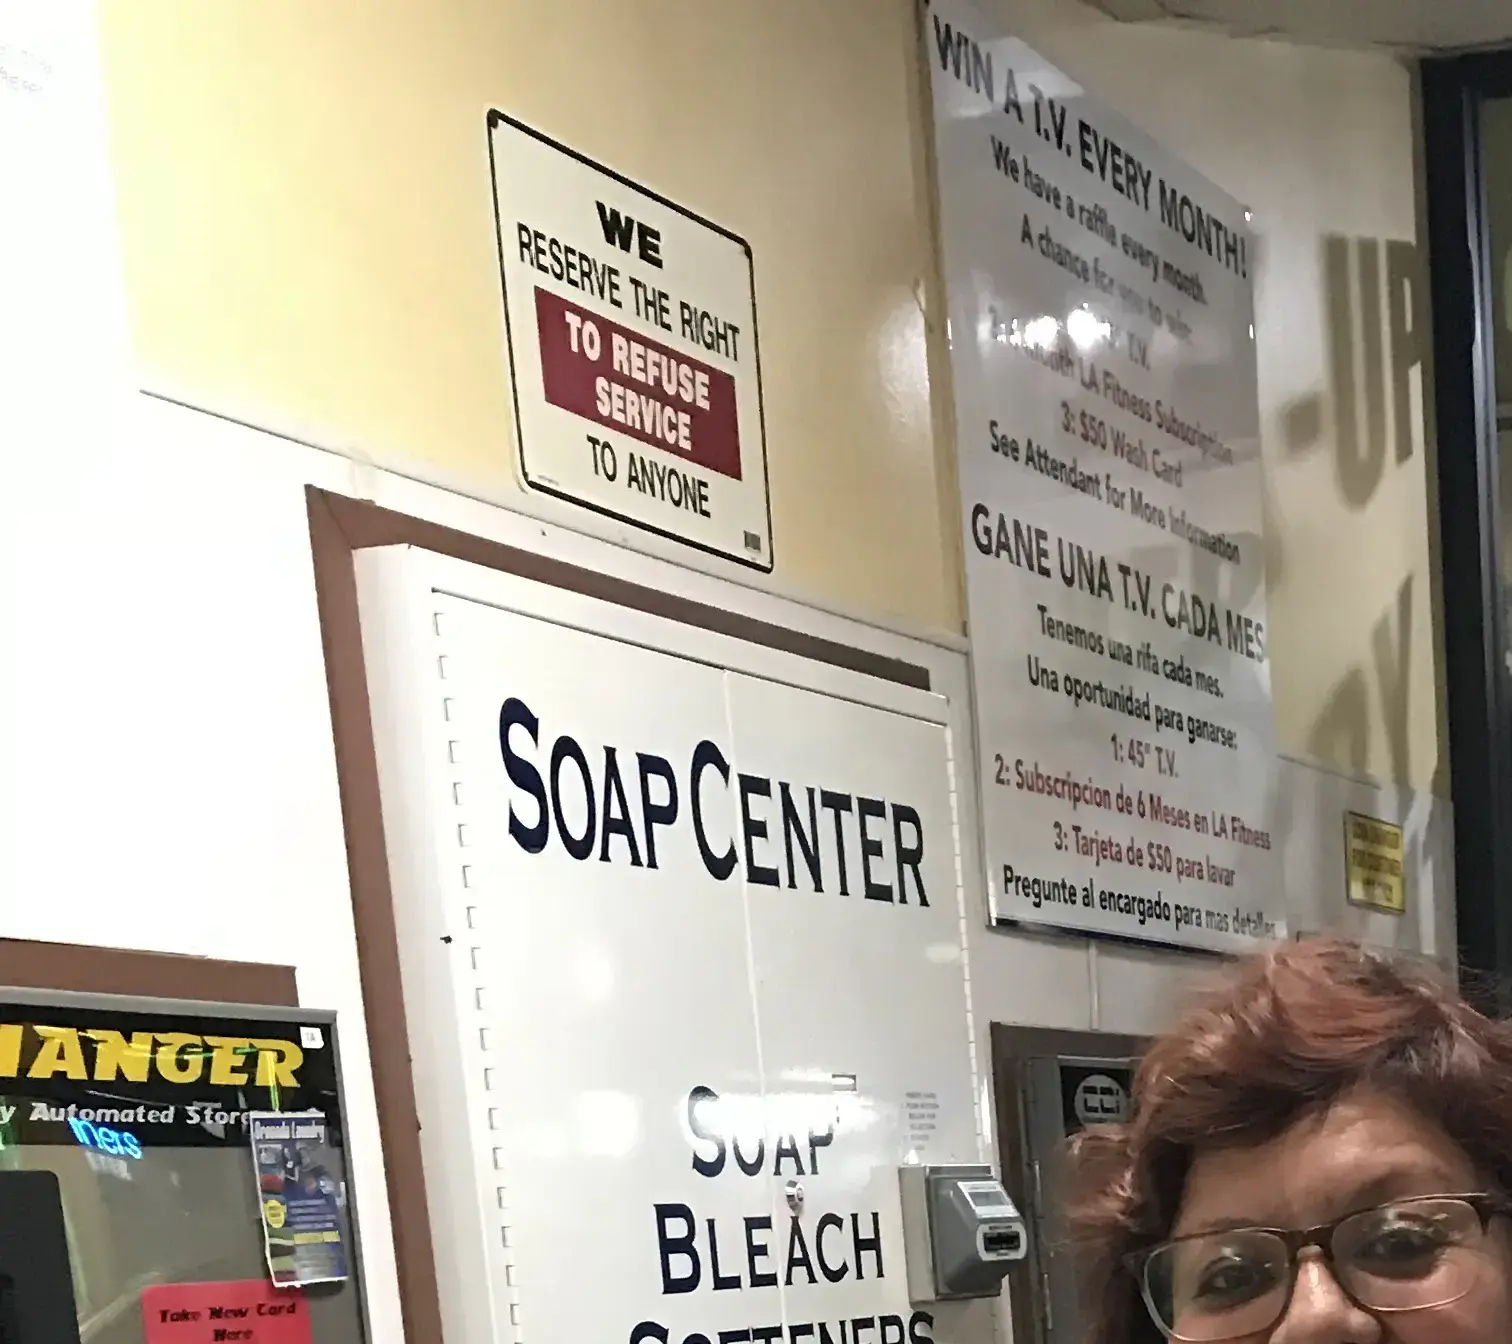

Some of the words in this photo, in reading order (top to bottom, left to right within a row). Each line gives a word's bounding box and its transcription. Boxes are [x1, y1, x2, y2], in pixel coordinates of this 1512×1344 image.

[933, 14, 995, 102] WIN
[1003, 68, 1023, 124] A
[1029, 82, 1072, 158] T.V.
[1078, 118, 1151, 211] EVERY
[1159, 178, 1247, 279] MONTH!
[595, 200, 663, 269] WE
[991, 134, 1019, 184] We
[1024, 155, 1061, 209] have
[1066, 194, 1075, 219] a
[1079, 202, 1117, 247] raffle
[1121, 232, 1159, 282] every
[1020, 213, 1034, 249] A
[1038, 225, 1090, 283] chance
[517, 222, 622, 309] RESERVE
[630, 275, 672, 331] THE
[680, 299, 739, 361] RIGHT
[565, 310, 600, 362] TO
[611, 332, 710, 410] REFUSE
[595, 376, 691, 451] SERVICE
[1061, 401, 1075, 434] 3:
[1080, 408, 1106, 450] $50
[1110, 426, 1148, 471] Wash
[1152, 448, 1183, 488] Card
[1080, 358, 1099, 394] LA
[1103, 369, 1152, 422] Fitness
[1154, 400, 1233, 465] Subscription
[587, 434, 617, 482] TO
[628, 452, 711, 519] ANYONE
[989, 419, 1019, 462] See
[1024, 437, 1101, 500] Attendant
[1105, 473, 1125, 510] for
[1129, 487, 1166, 529] More
[1169, 505, 1240, 565] Information
[972, 503, 1051, 578] GANE
[1057, 537, 1114, 602] UNA
[1117, 562, 1155, 619] T.V.
[1162, 583, 1222, 646] CADA
[1226, 609, 1264, 663] MES
[1037, 604, 1104, 656] Tenemos
[1108, 639, 1132, 666] una
[1137, 641, 1159, 675] rifa
[1163, 655, 1192, 687] cada
[1196, 671, 1224, 698] mes.
[1027, 654, 1059, 692] Una
[1064, 672, 1150, 721] oportunidad
[1154, 704, 1183, 732] para
[1187, 715, 1238, 750] ganarse:
[1111, 733, 1124, 762] 1:
[1127, 739, 1151, 768] 45"
[1154, 746, 1178, 778] T.V.
[499, 696, 678, 870] SOAP
[690, 740, 930, 908] CENTER
[994, 754, 1010, 786] 2:
[1016, 759, 1111, 811] Subscripcion
[1115, 784, 1132, 815] de
[1137, 790, 1146, 819] 6
[1149, 793, 1191, 831] Meses
[1194, 813, 1208, 835] en
[1212, 810, 1228, 840] LA
[1231, 816, 1271, 850] Fitness
[1003, 864, 1077, 908] Pregunte
[1082, 877, 1095, 909] al
[1099, 891, 1171, 925] encargado
[1174, 902, 1202, 932] para
[1205, 907, 1229, 932] mas
[1053, 821, 1068, 852] 3:
[1072, 825, 1122, 867] Tarjeta
[1127, 837, 1143, 867] de
[1147, 841, 1172, 874] $50
[1176, 856, 1204, 884] para
[1206, 855, 1235, 888] lavar
[29, 1101, 174, 1125] Automated
[687, 1085, 835, 1177] SOAP
[654, 1202, 885, 1295] BLEACH
[159, 1308, 201, 1324] Take
[207, 1306, 249, 1320] New
[257, 1302, 296, 1316] Card
[213, 1328, 253, 1342] Here
